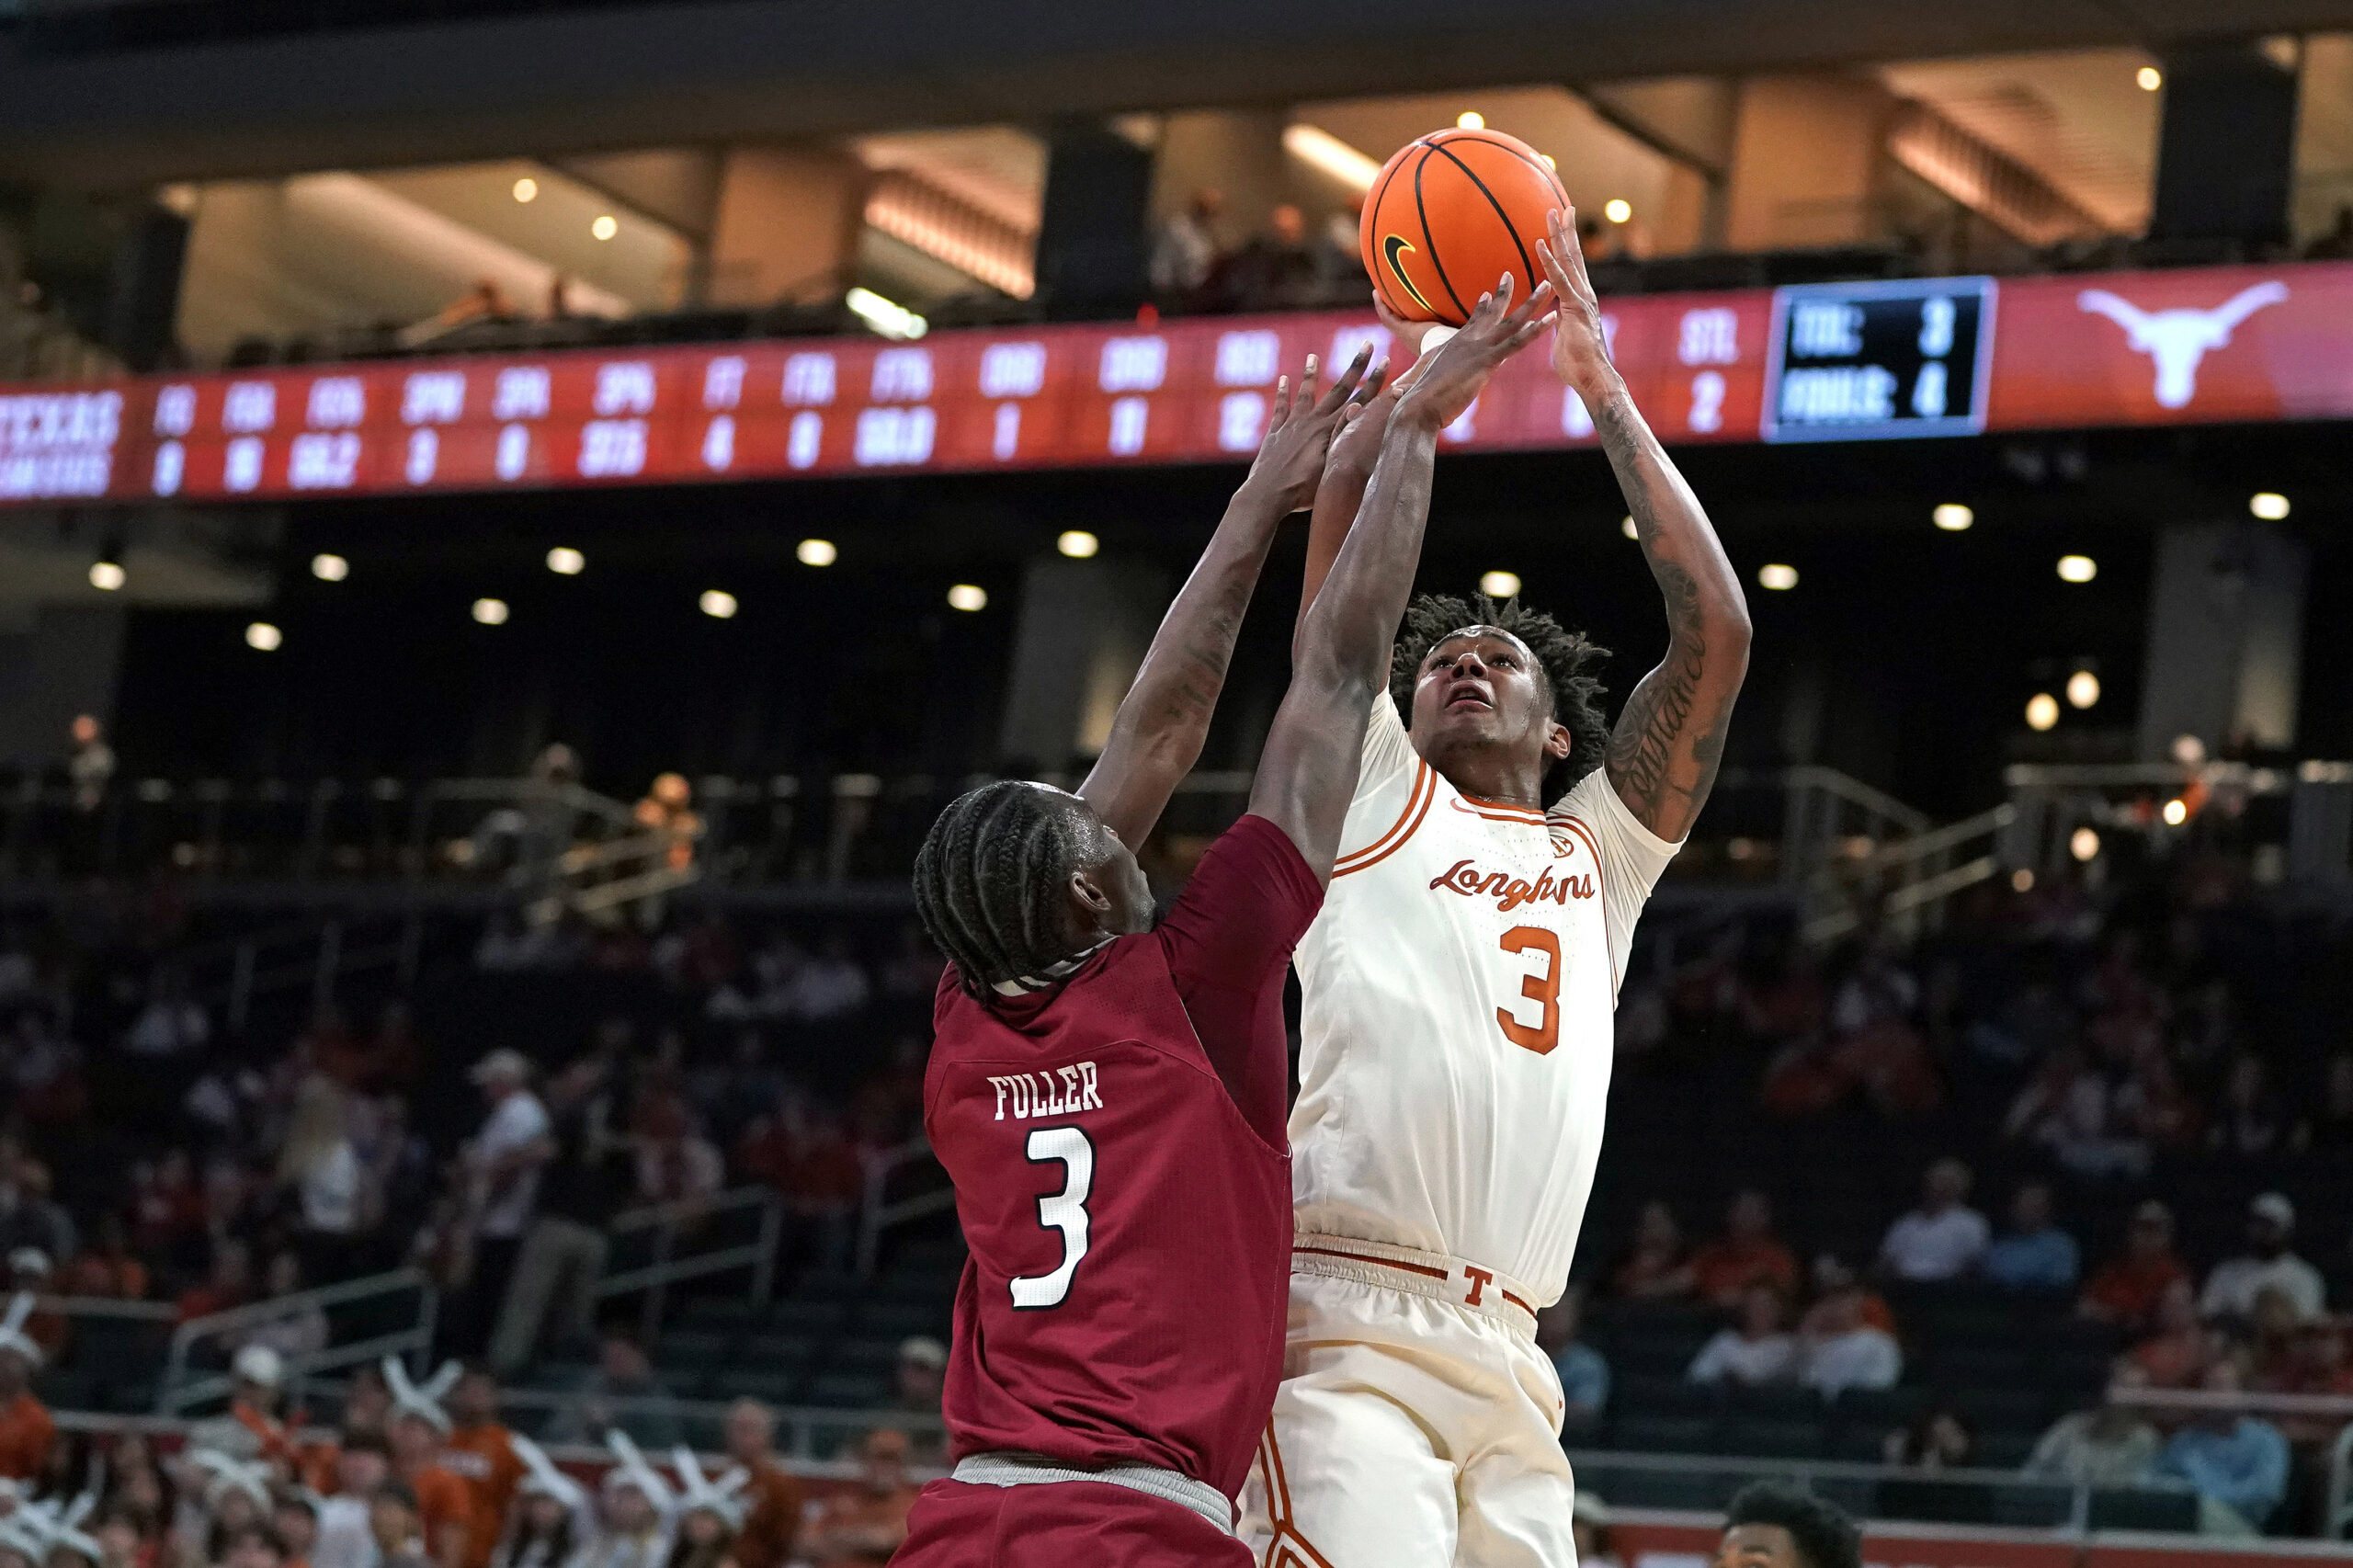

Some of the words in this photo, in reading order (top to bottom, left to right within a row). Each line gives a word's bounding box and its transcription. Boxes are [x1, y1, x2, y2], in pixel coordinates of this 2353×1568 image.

[1688, 370, 1726, 433] 2
[1912, 361, 1948, 421] 4
[1496, 925, 1562, 1055] 3
[987, 1061, 1103, 1121] FULLER
[1010, 1124, 1097, 1308] 3
[1464, 1265, 1493, 1307] T
